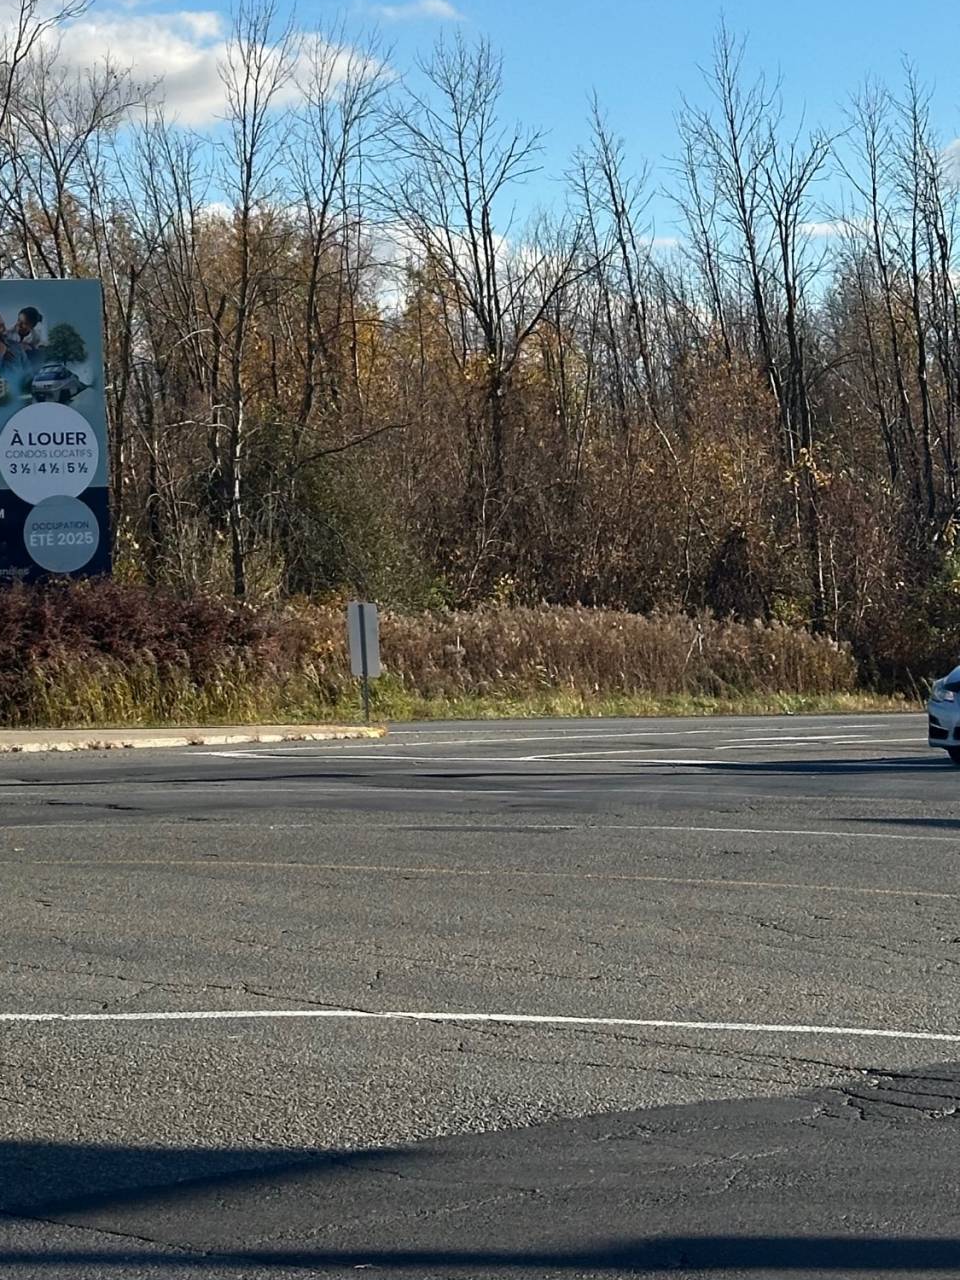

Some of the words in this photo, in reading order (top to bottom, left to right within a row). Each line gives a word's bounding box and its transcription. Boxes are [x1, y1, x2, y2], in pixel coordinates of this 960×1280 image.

[10, 429, 24, 446] À
[29, 432, 87, 446] LOUER
[5, 449, 47, 459] CONDOS
[49, 448, 93, 458] LOCATIFS
[31, 520, 89, 530] OCCUPATION
[30, 530, 54, 547] ÉTÉ
[57, 531, 94, 546] 2025
